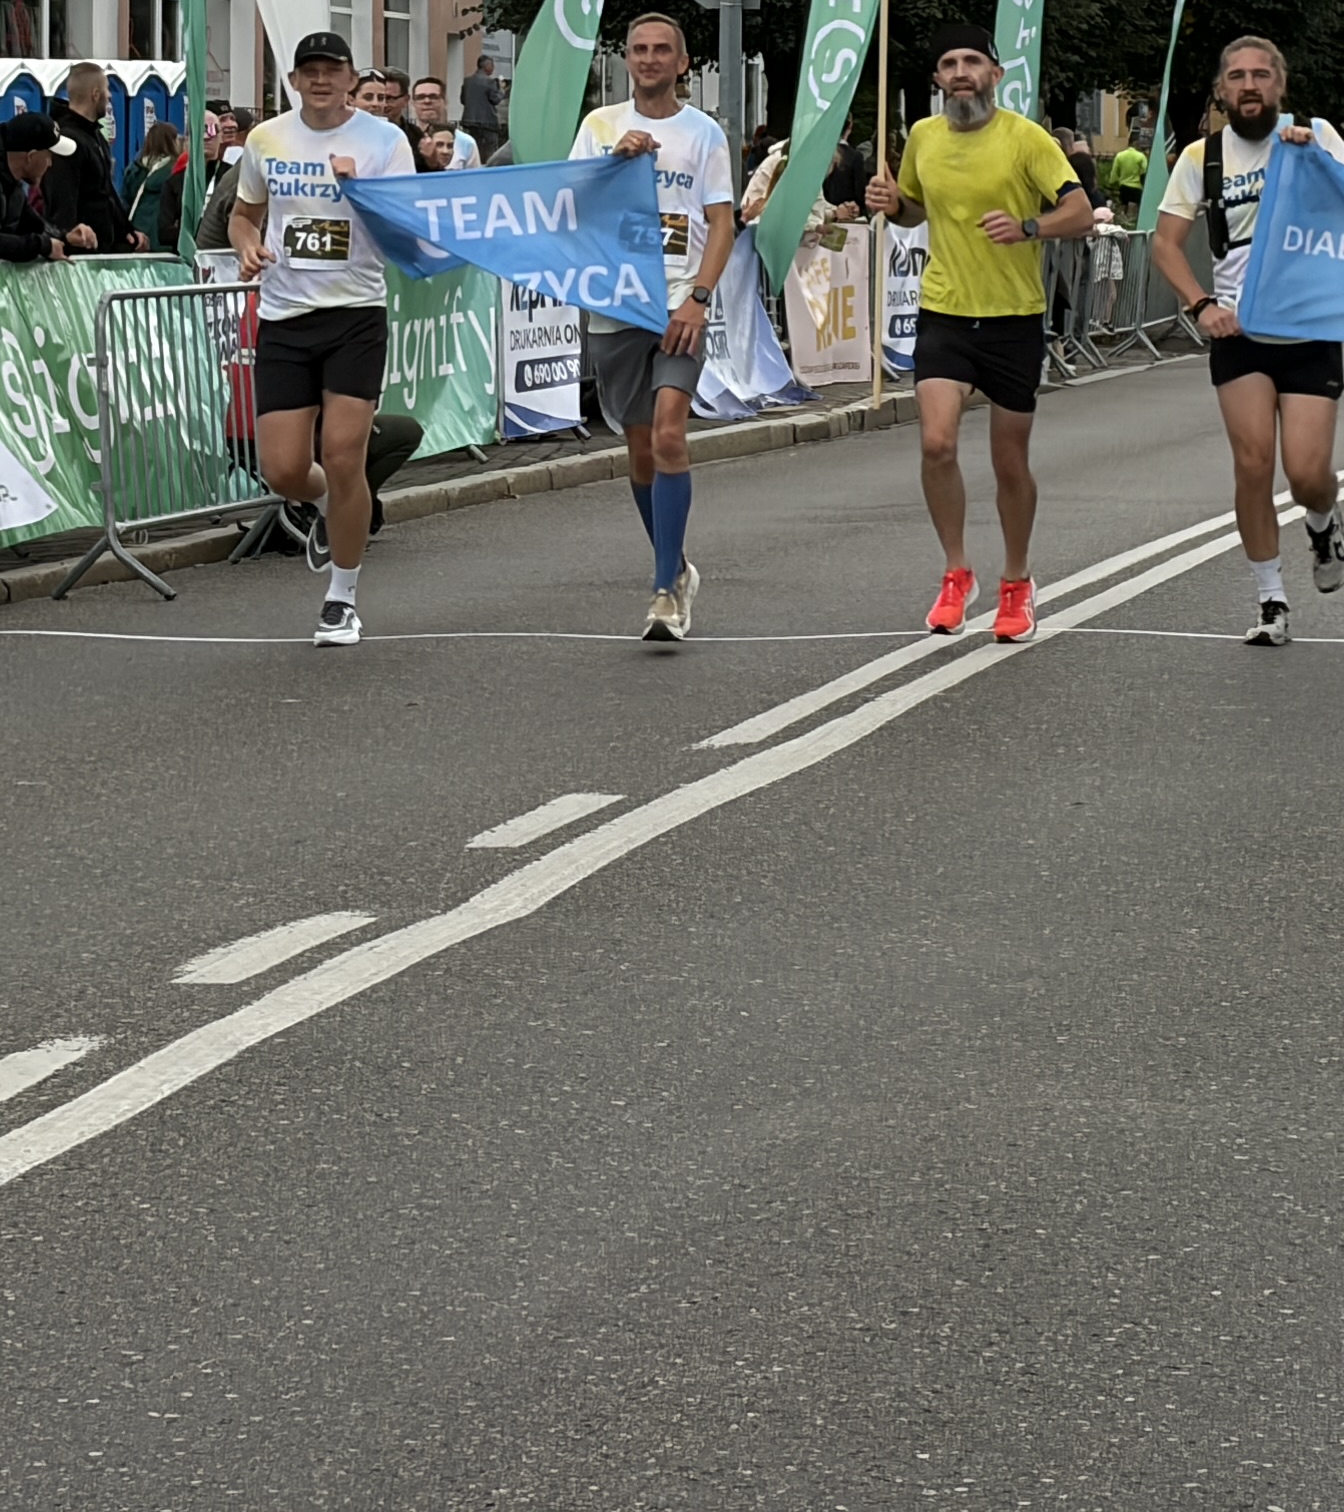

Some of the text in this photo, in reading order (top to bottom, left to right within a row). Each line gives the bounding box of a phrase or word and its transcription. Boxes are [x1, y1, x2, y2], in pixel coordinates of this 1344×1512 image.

[265, 157, 326, 177] Team
[654, 169, 695, 190] zyca
[1222, 167, 1267, 190] eam
[267, 178, 344, 203] Cukrzy
[414, 187, 578, 243] TEAM
[294, 231, 333, 252] 761
[513, 262, 651, 308] ZYCA
[389, 286, 496, 410] ignify
[510, 323, 581, 352] DRUKARNIA ON
